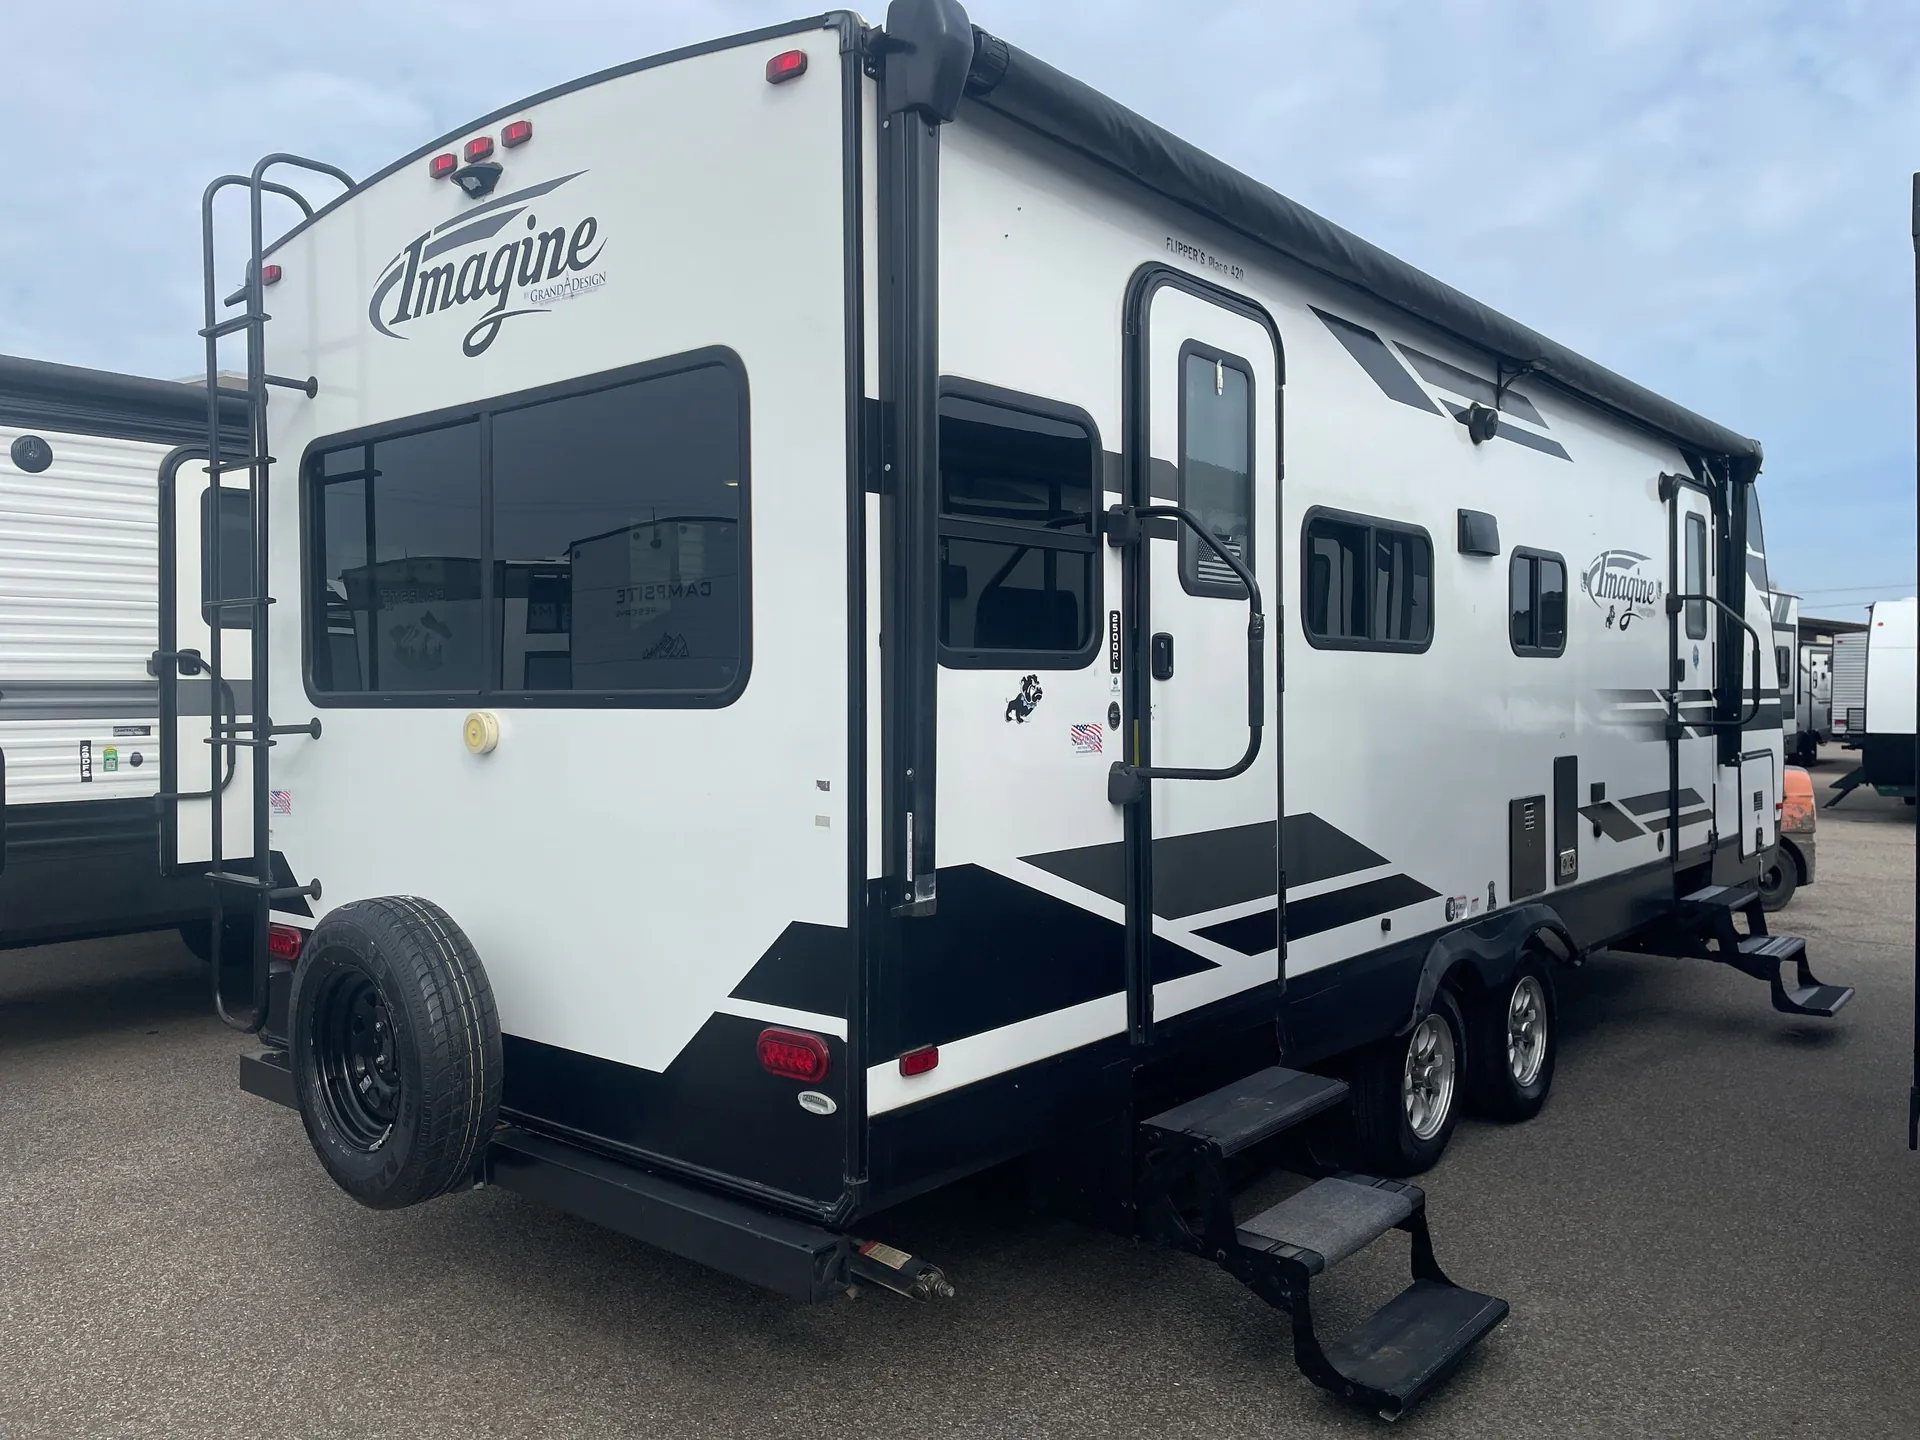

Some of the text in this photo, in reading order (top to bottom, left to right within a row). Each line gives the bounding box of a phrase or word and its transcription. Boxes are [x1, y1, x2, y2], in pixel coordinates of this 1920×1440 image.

[1166, 237, 1206, 264] FLIPPER'S
[387, 214, 608, 358] Imagine
[572, 271, 607, 291] DESIGN
[1594, 550, 1656, 632] Imagine
[1111, 613, 1119, 670] 2500RL
[82, 746, 90, 777] 29DFS
